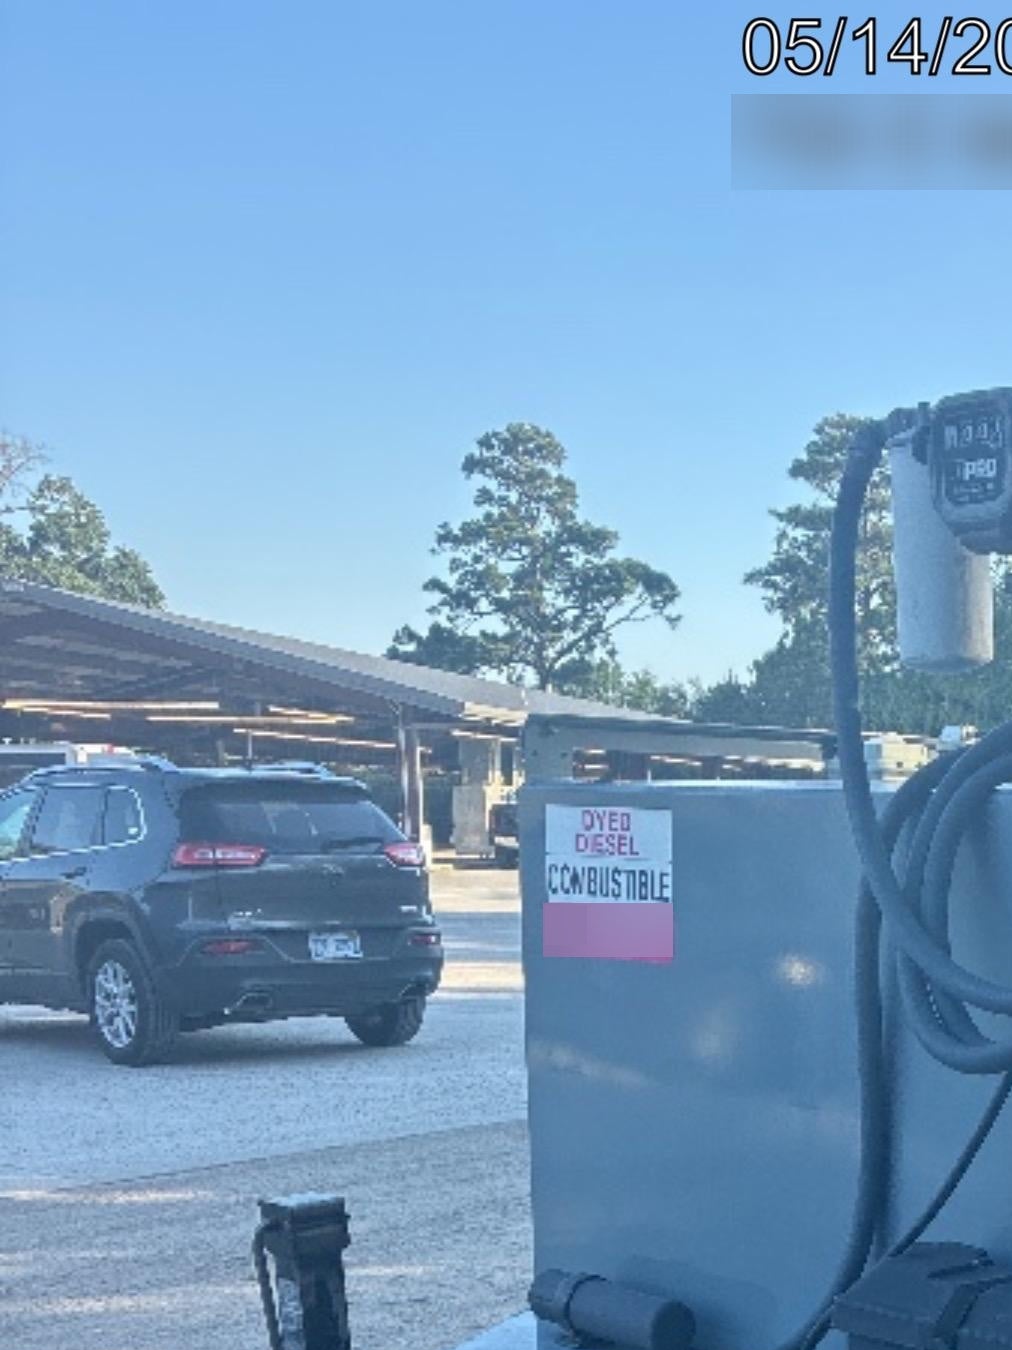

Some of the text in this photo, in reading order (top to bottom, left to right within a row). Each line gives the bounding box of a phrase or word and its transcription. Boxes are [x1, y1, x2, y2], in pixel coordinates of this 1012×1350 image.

[581, 809, 632, 832] DYED
[575, 833, 640, 856] DIESEL
[548, 863, 671, 903] COMBUSTIBLE
